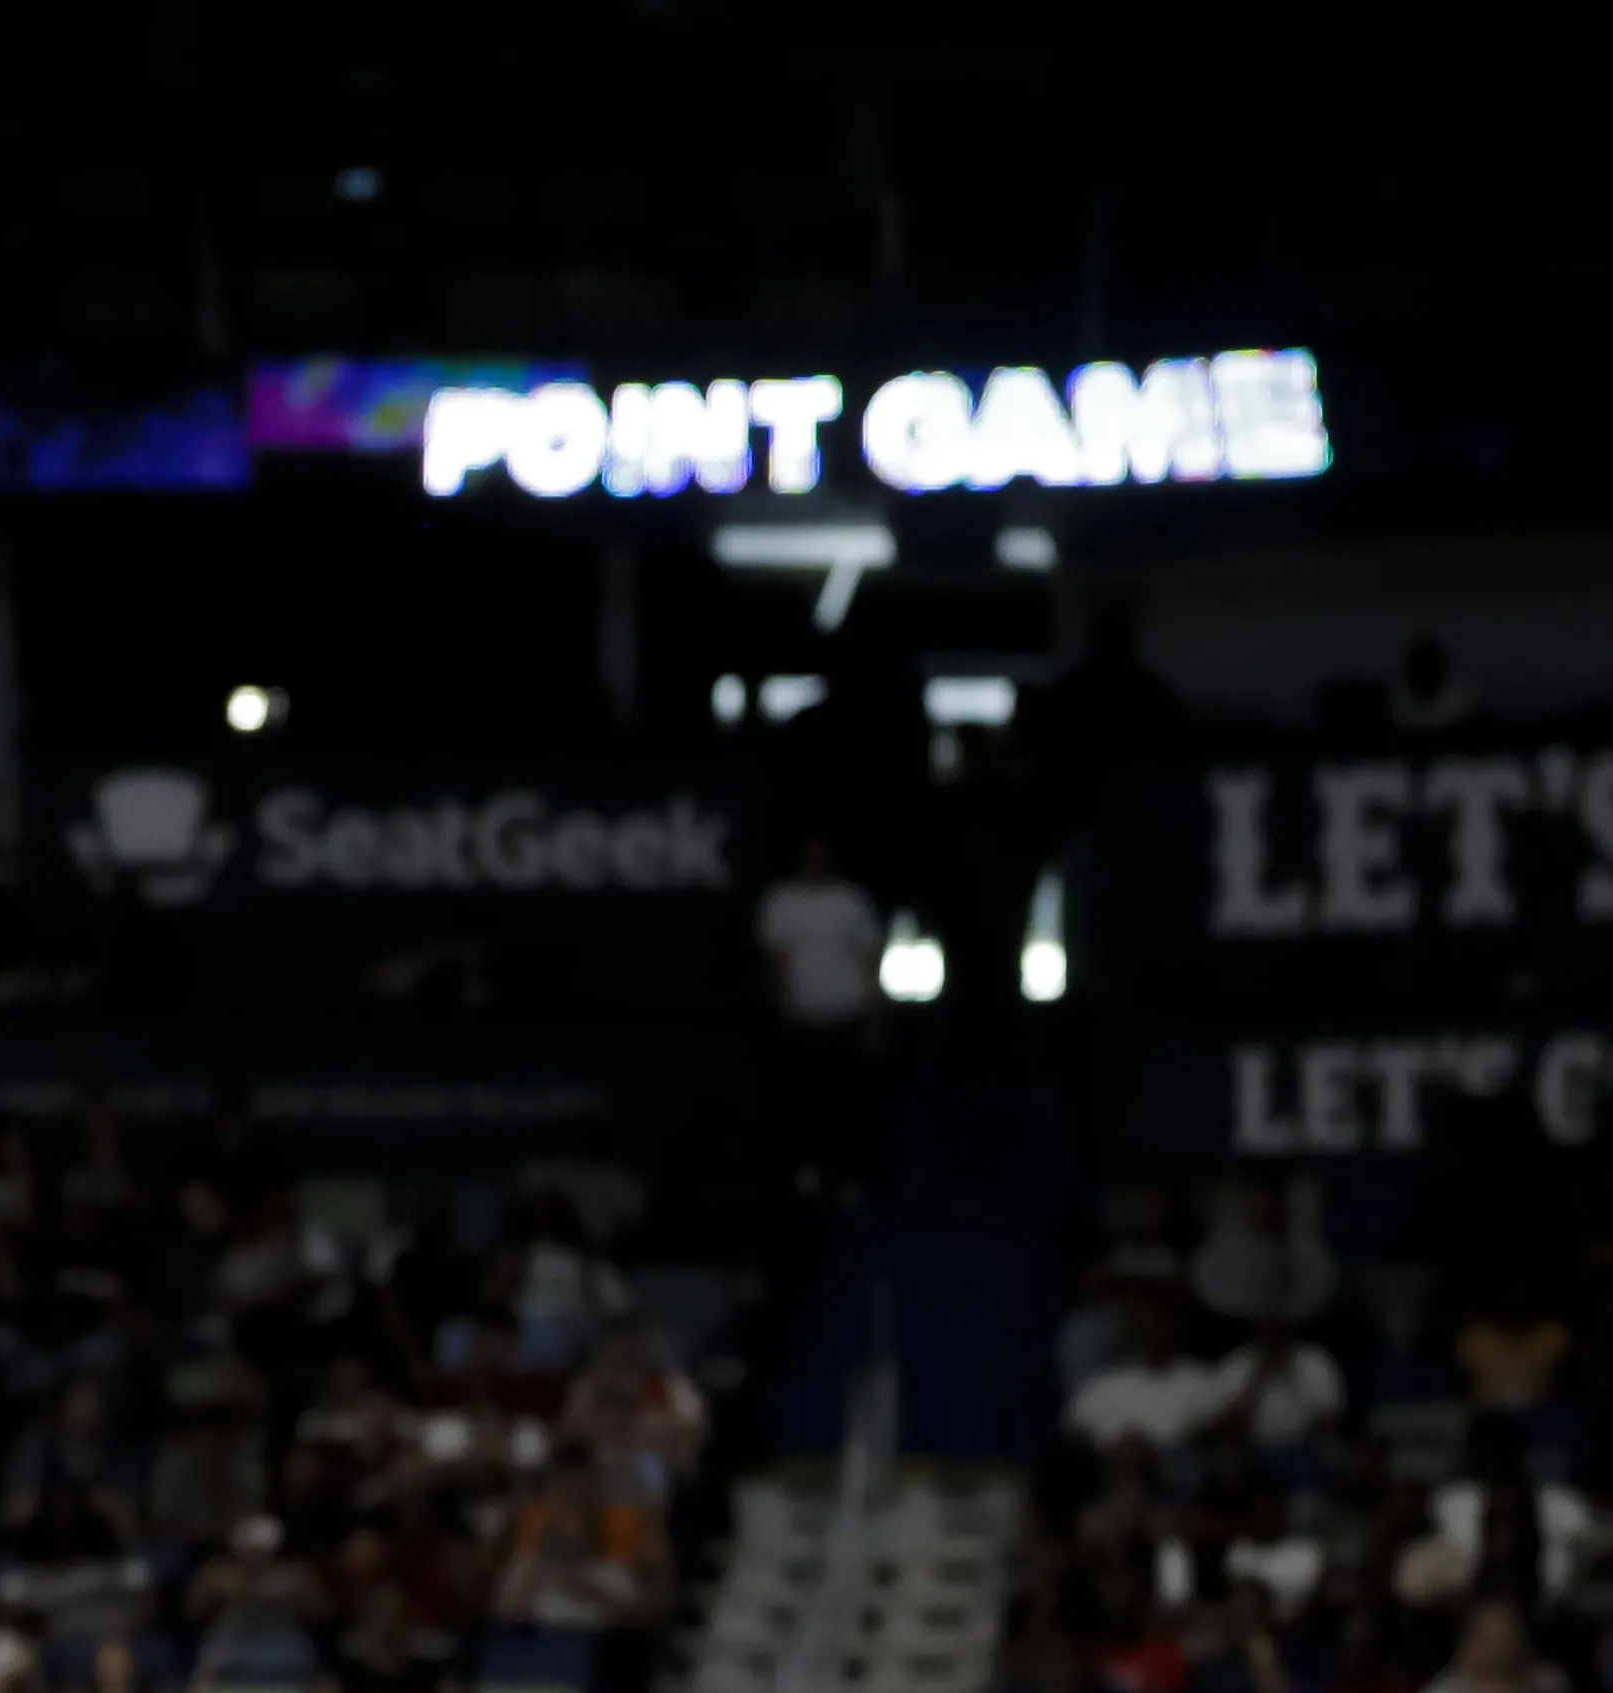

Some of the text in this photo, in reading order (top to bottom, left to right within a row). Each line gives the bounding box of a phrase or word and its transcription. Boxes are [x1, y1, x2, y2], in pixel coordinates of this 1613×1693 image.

[422, 346, 1333, 498] POINT GAME
[252, 783, 734, 892] SeatGeek
